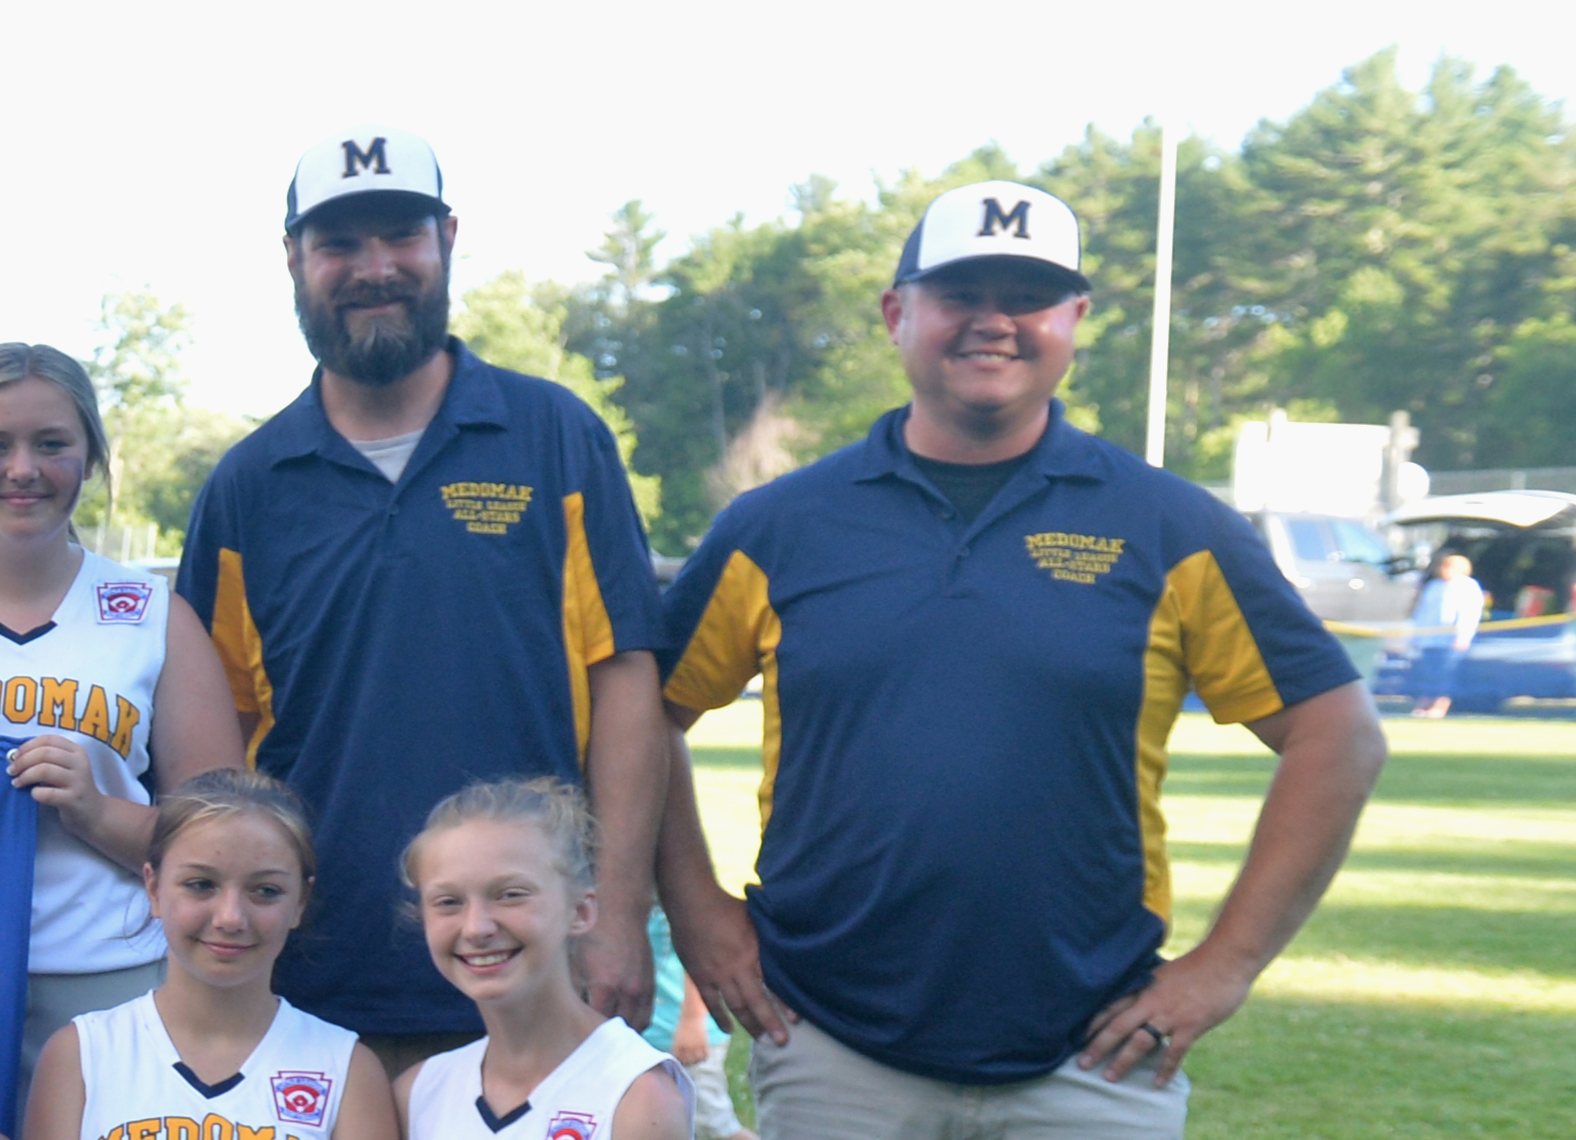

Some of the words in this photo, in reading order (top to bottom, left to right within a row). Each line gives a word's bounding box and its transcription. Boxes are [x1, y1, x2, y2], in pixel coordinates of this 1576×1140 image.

[341, 136, 392, 179] M
[976, 197, 1032, 240] M
[440, 482, 533, 502] MEDOMAK
[1024, 532, 1126, 554] MEDOMAK
